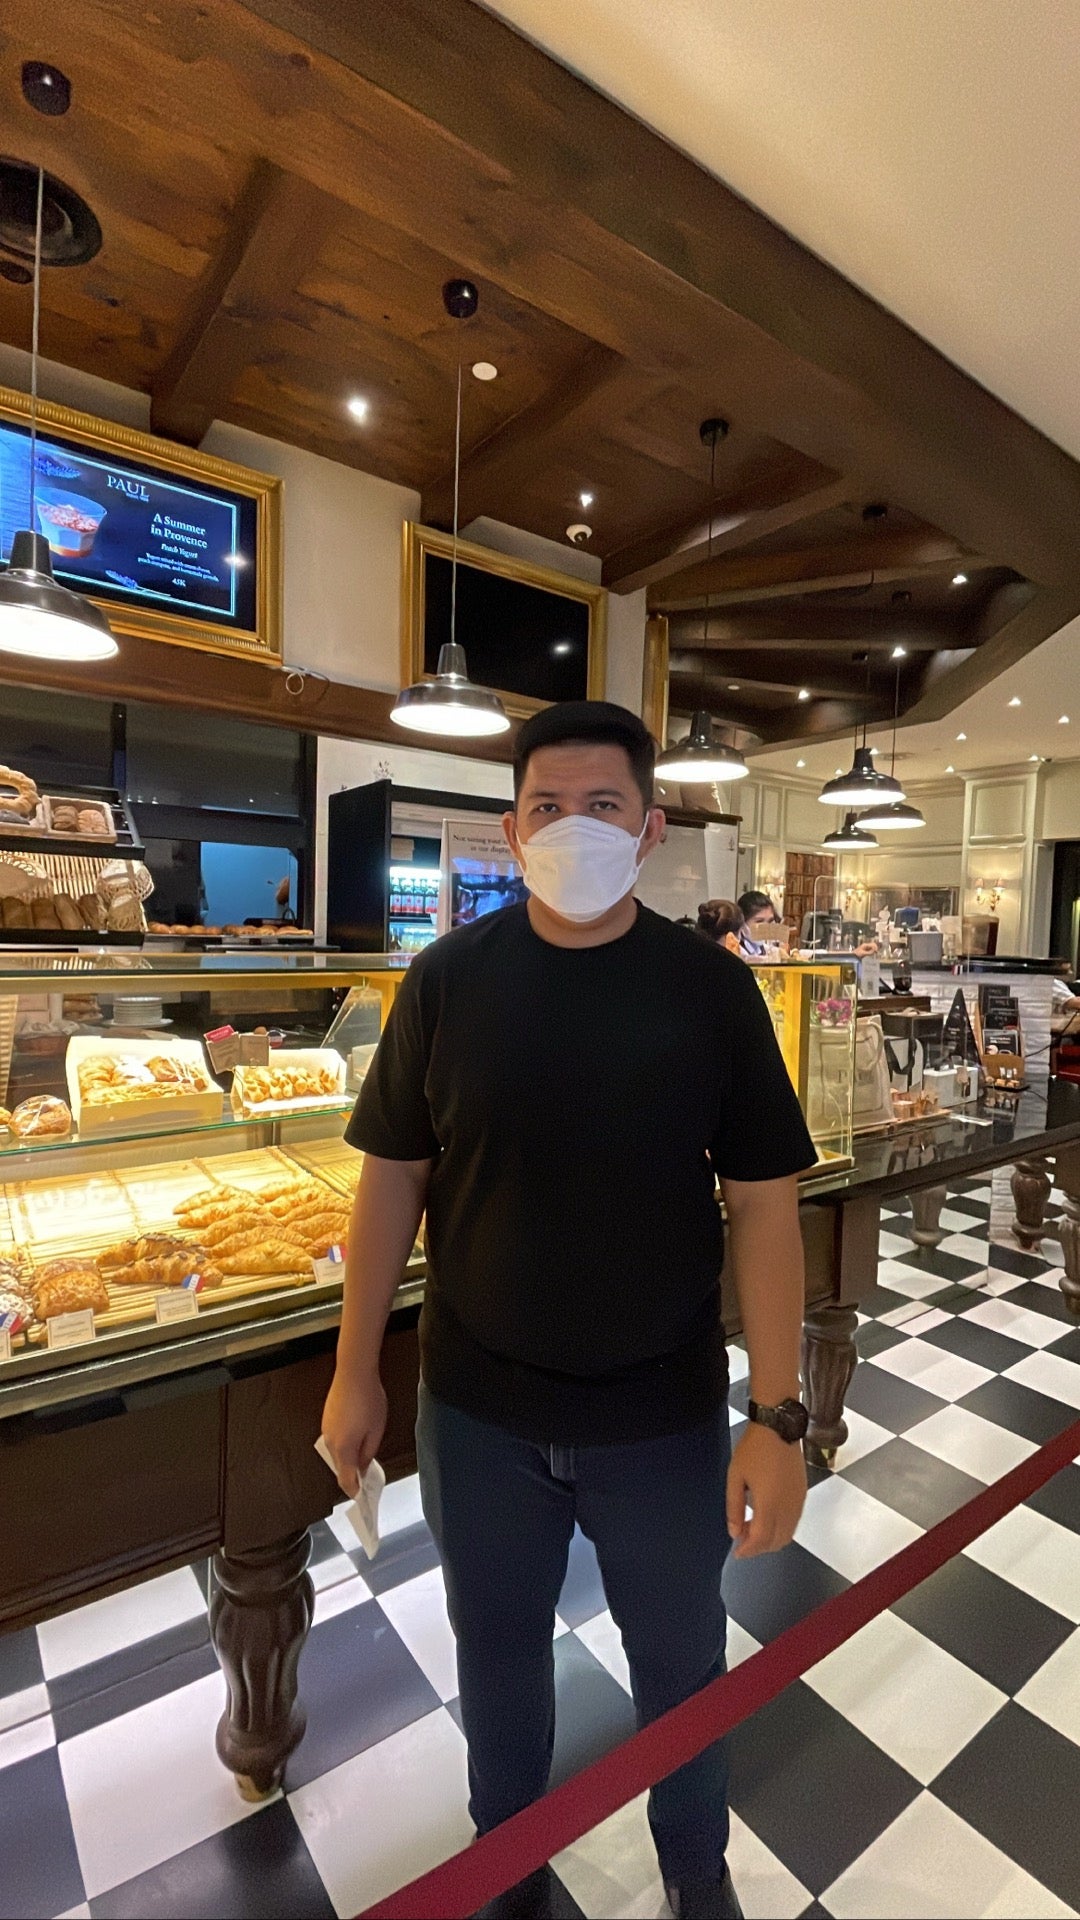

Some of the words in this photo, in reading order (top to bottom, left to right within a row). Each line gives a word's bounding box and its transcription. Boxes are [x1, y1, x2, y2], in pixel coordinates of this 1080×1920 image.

[107, 474, 150, 497] PAUL
[153, 512, 163, 524] A
[164, 516, 206, 536] Summer
[150, 524, 163, 537] in
[164, 528, 208, 549] Provence
[179, 547, 198, 559] Yogurt
